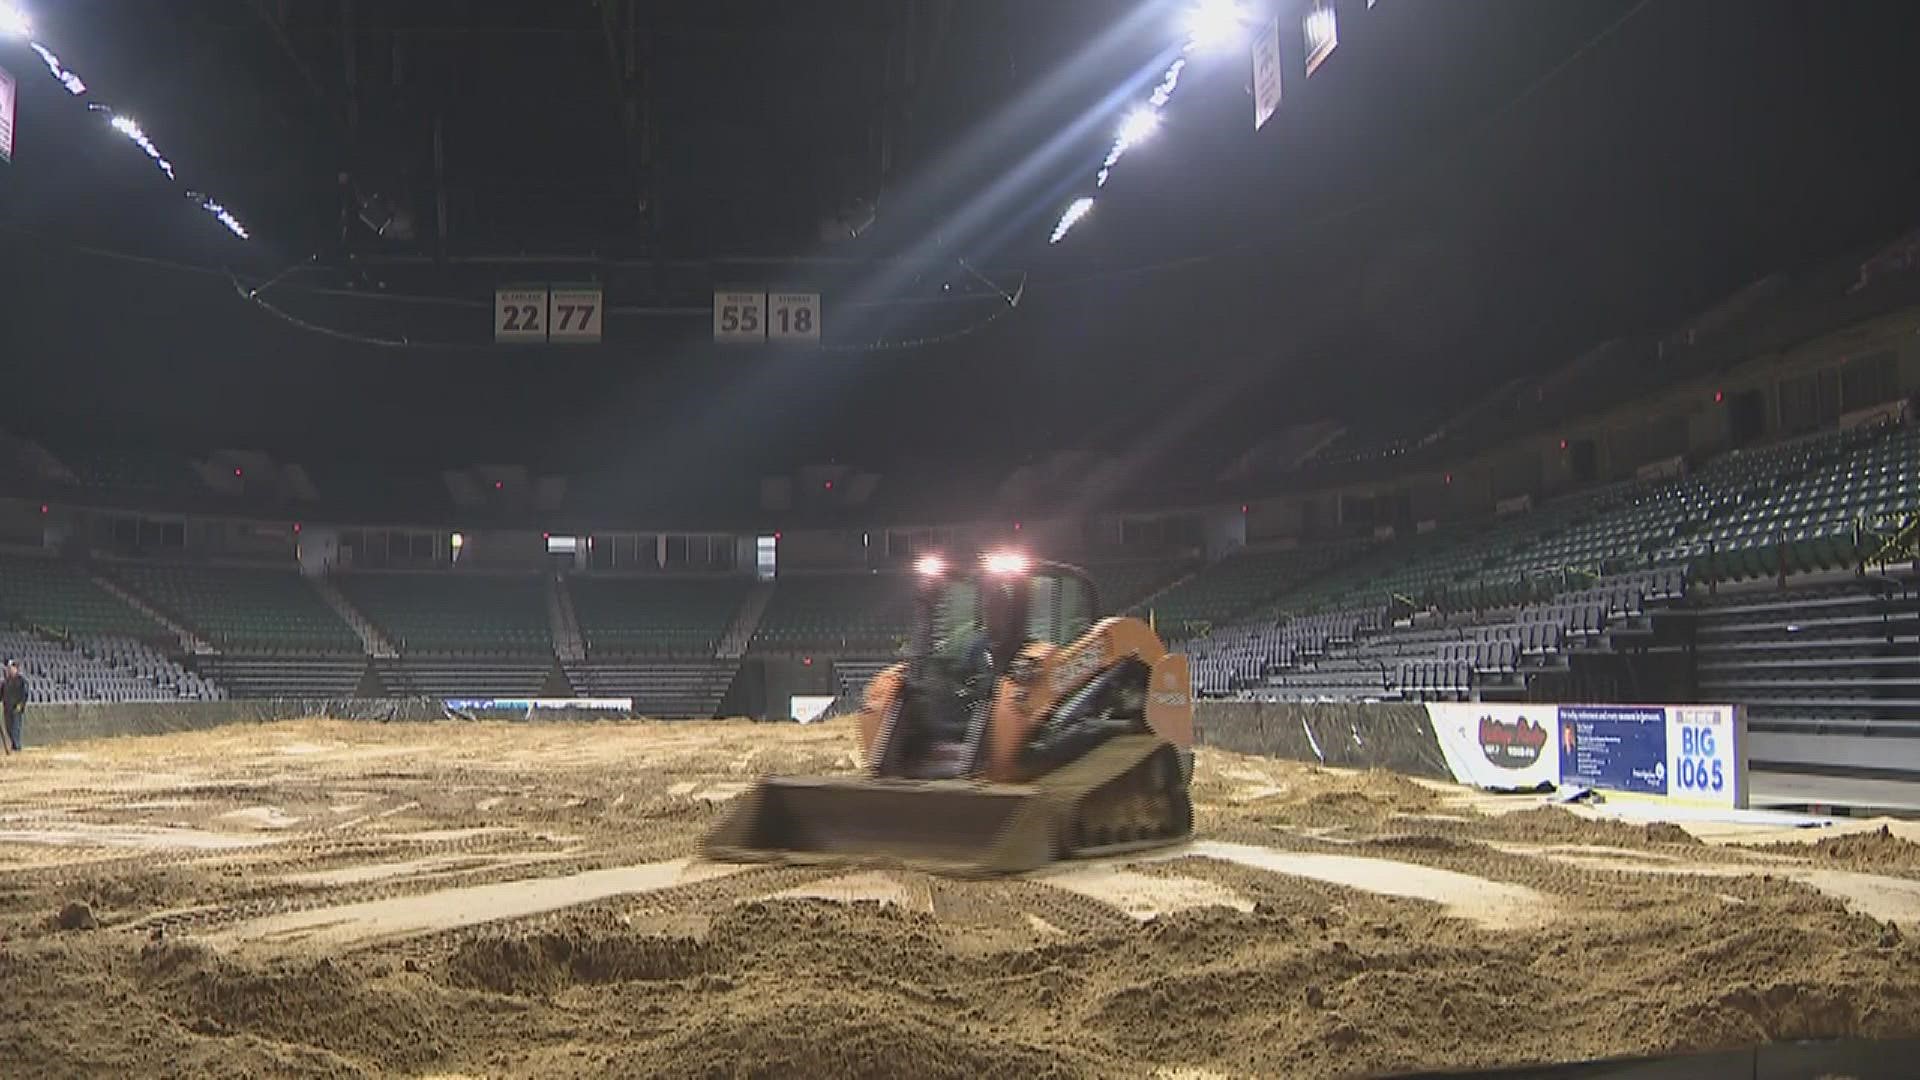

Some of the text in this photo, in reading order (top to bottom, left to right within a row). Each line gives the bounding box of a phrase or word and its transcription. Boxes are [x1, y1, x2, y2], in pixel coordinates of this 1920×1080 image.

[503, 304, 539, 330] 22
[557, 304, 594, 331] 77
[721, 304, 758, 332] 55
[777, 306, 812, 332] 18
[1682, 725, 1715, 757] BIG
